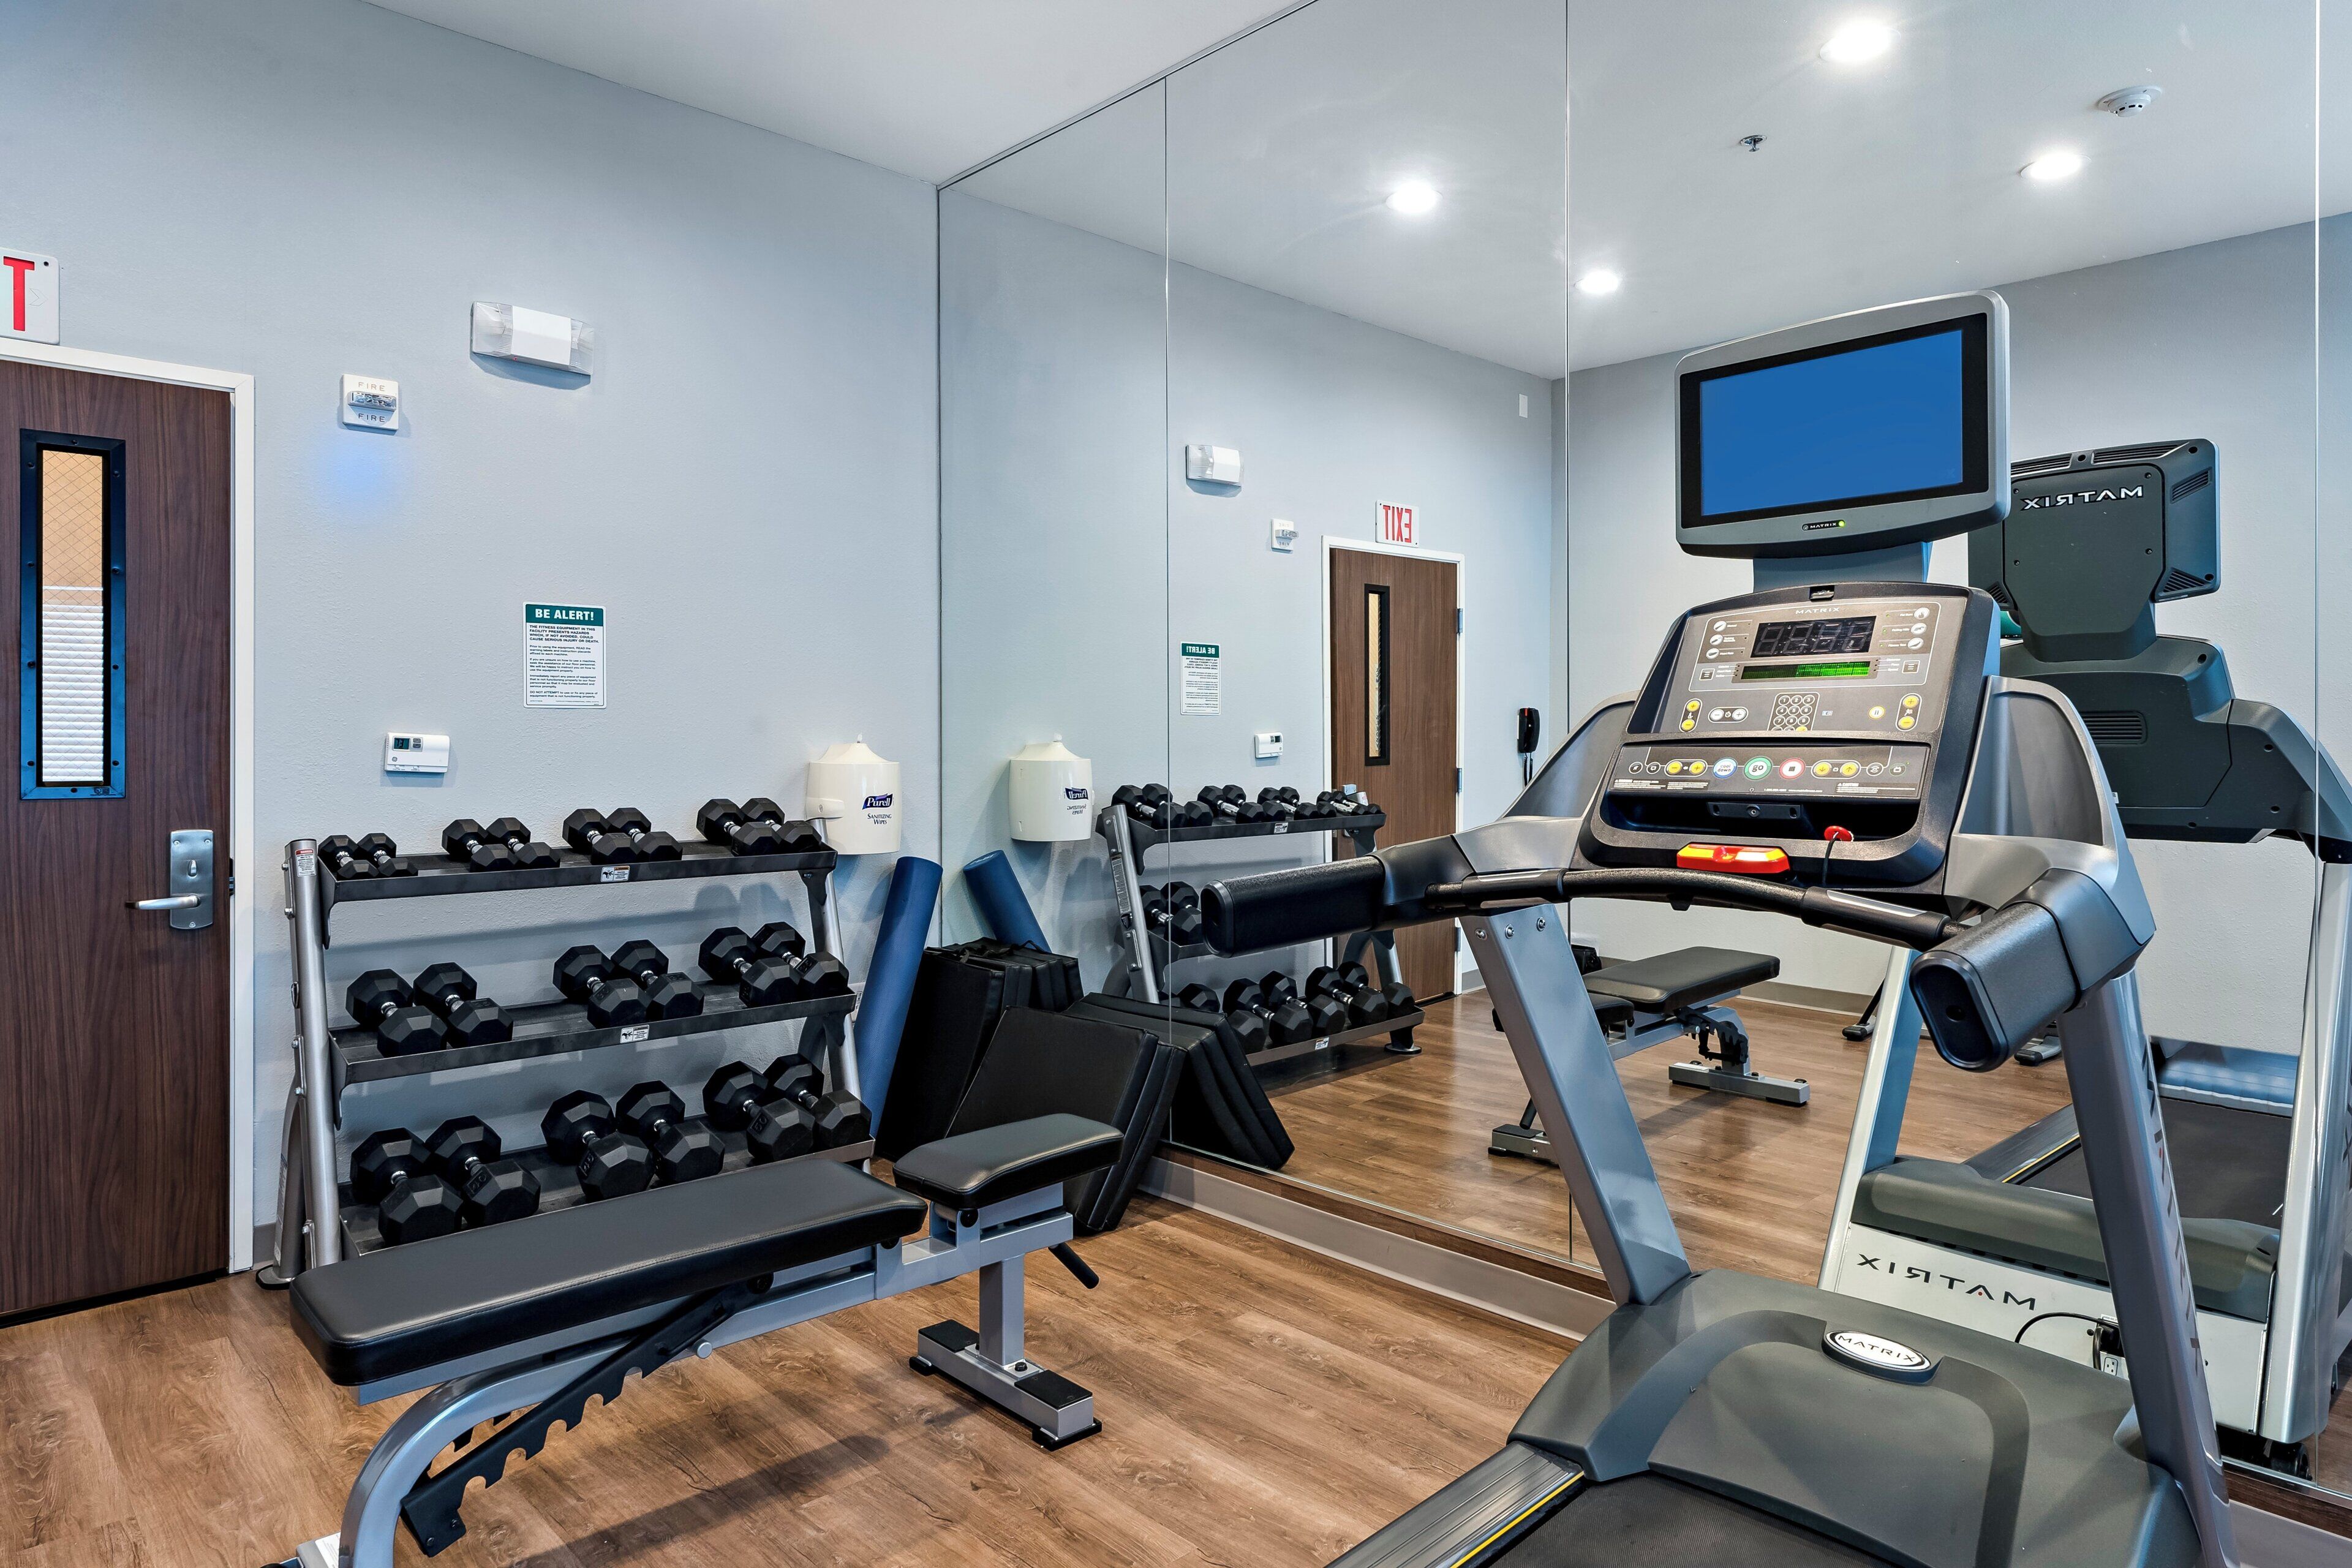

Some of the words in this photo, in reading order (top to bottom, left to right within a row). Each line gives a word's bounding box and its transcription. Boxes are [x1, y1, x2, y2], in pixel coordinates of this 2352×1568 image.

[3, 256, 34, 331] T
[358, 382, 385, 391] FIRE
[358, 413, 385, 422] FIRE
[535, 609, 550, 618] BE
[554, 610, 594, 621] ALERT!
[867, 797, 890, 806] Purell
[754, 1117, 767, 1131] 50
[472, 1174, 487, 1189] 40
[1838, 1335, 1916, 1362] MATRIX
